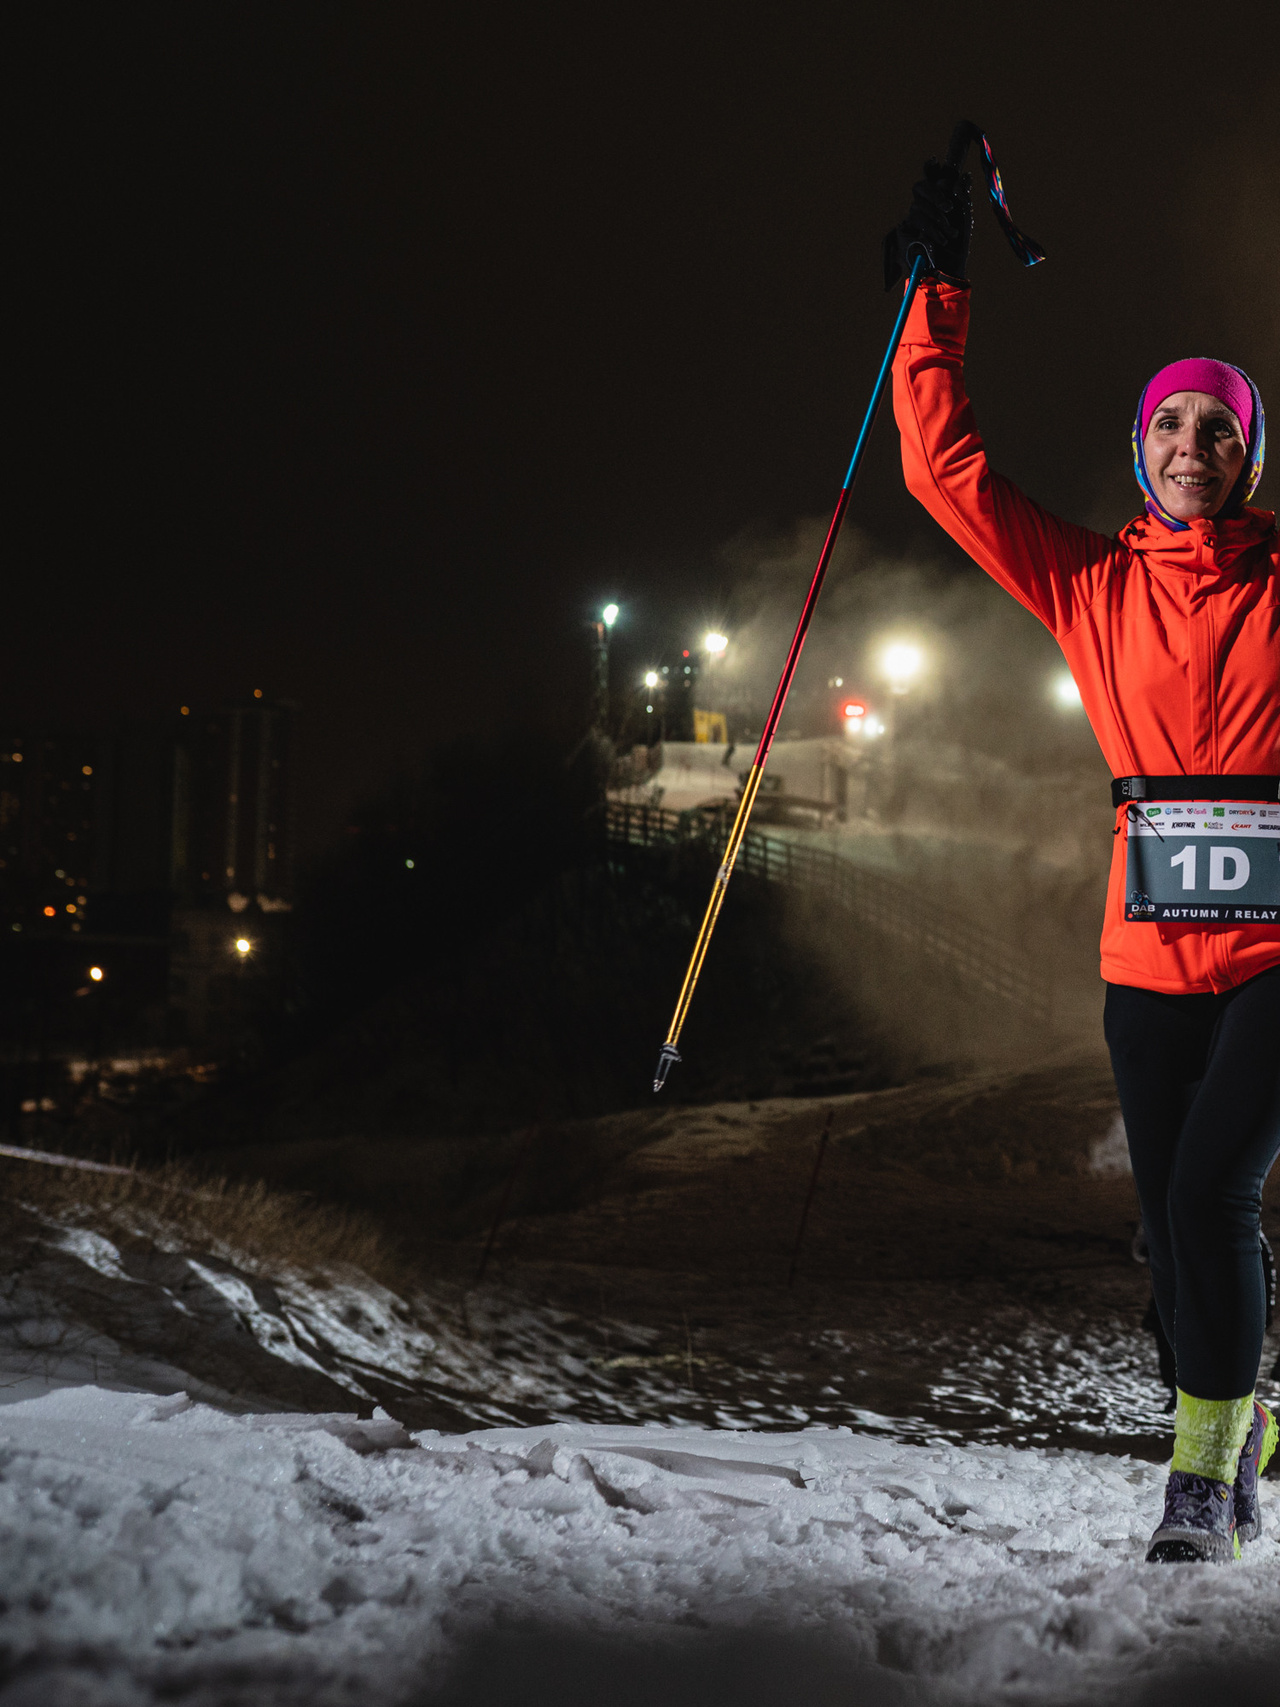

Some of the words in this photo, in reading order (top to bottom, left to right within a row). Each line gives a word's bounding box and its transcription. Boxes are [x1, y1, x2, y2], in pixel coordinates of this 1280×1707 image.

[1171, 845, 1250, 890] 1D
[1131, 904, 1156, 912] DAB
[1162, 908, 1220, 918] AUTUMN
[1234, 910, 1279, 920] RELAY
